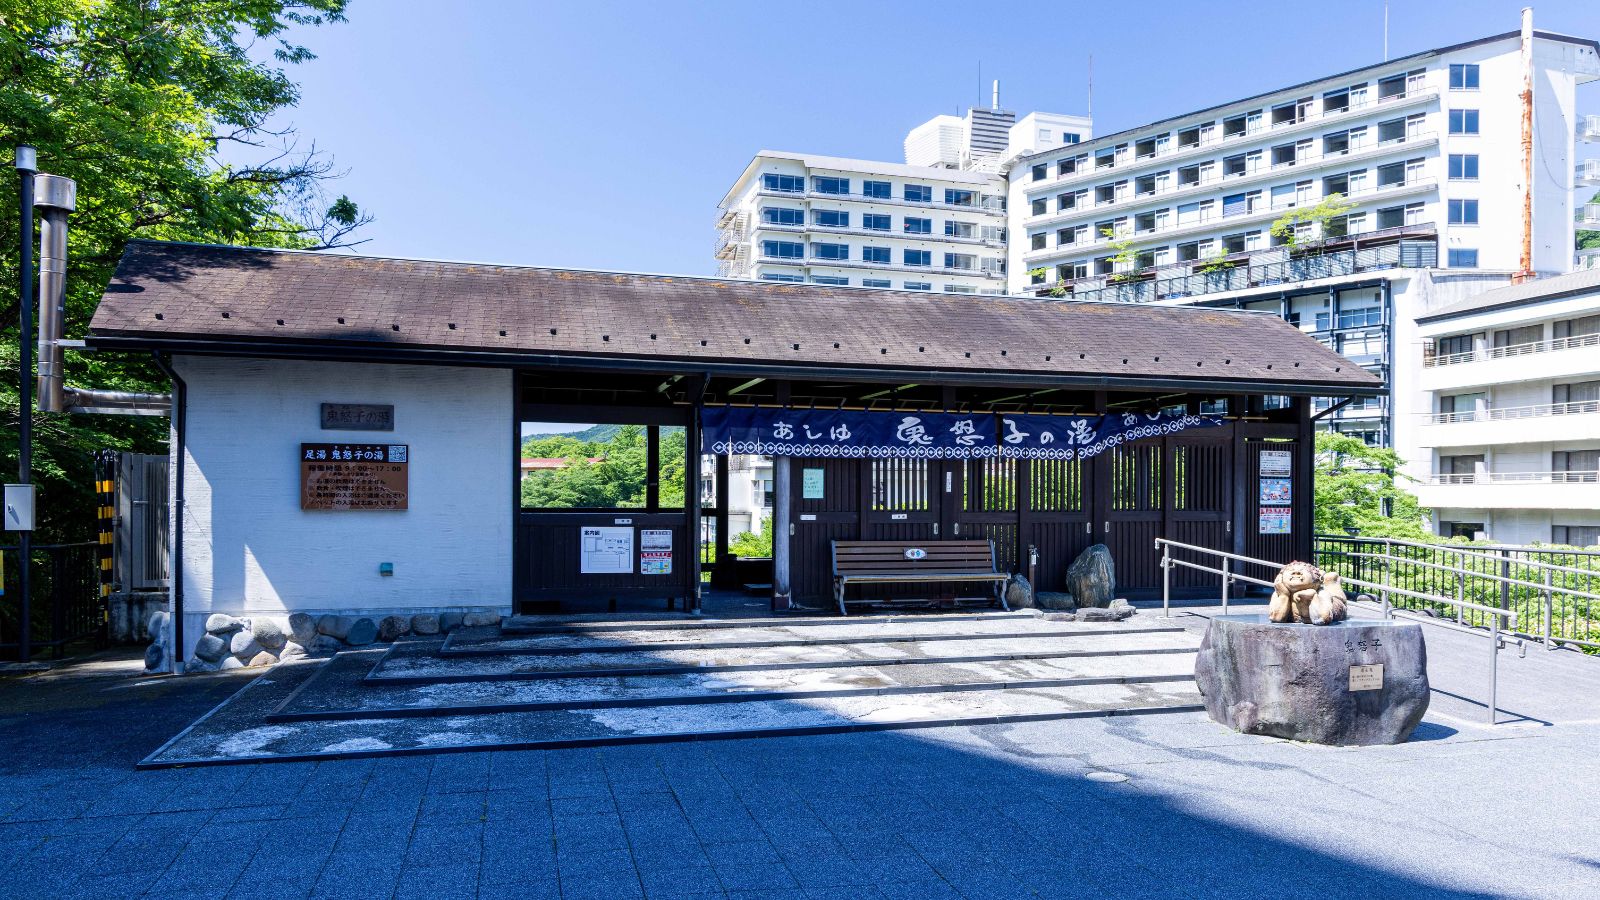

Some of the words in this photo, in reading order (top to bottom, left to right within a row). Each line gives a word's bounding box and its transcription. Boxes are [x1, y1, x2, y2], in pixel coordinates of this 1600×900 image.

[773, 420, 852, 442] あしゆ
[305, 449, 327, 460] 足湯
[331, 450, 384, 460] 鬼怒子の湯
[1344, 638, 1383, 654] 鬼怒子
